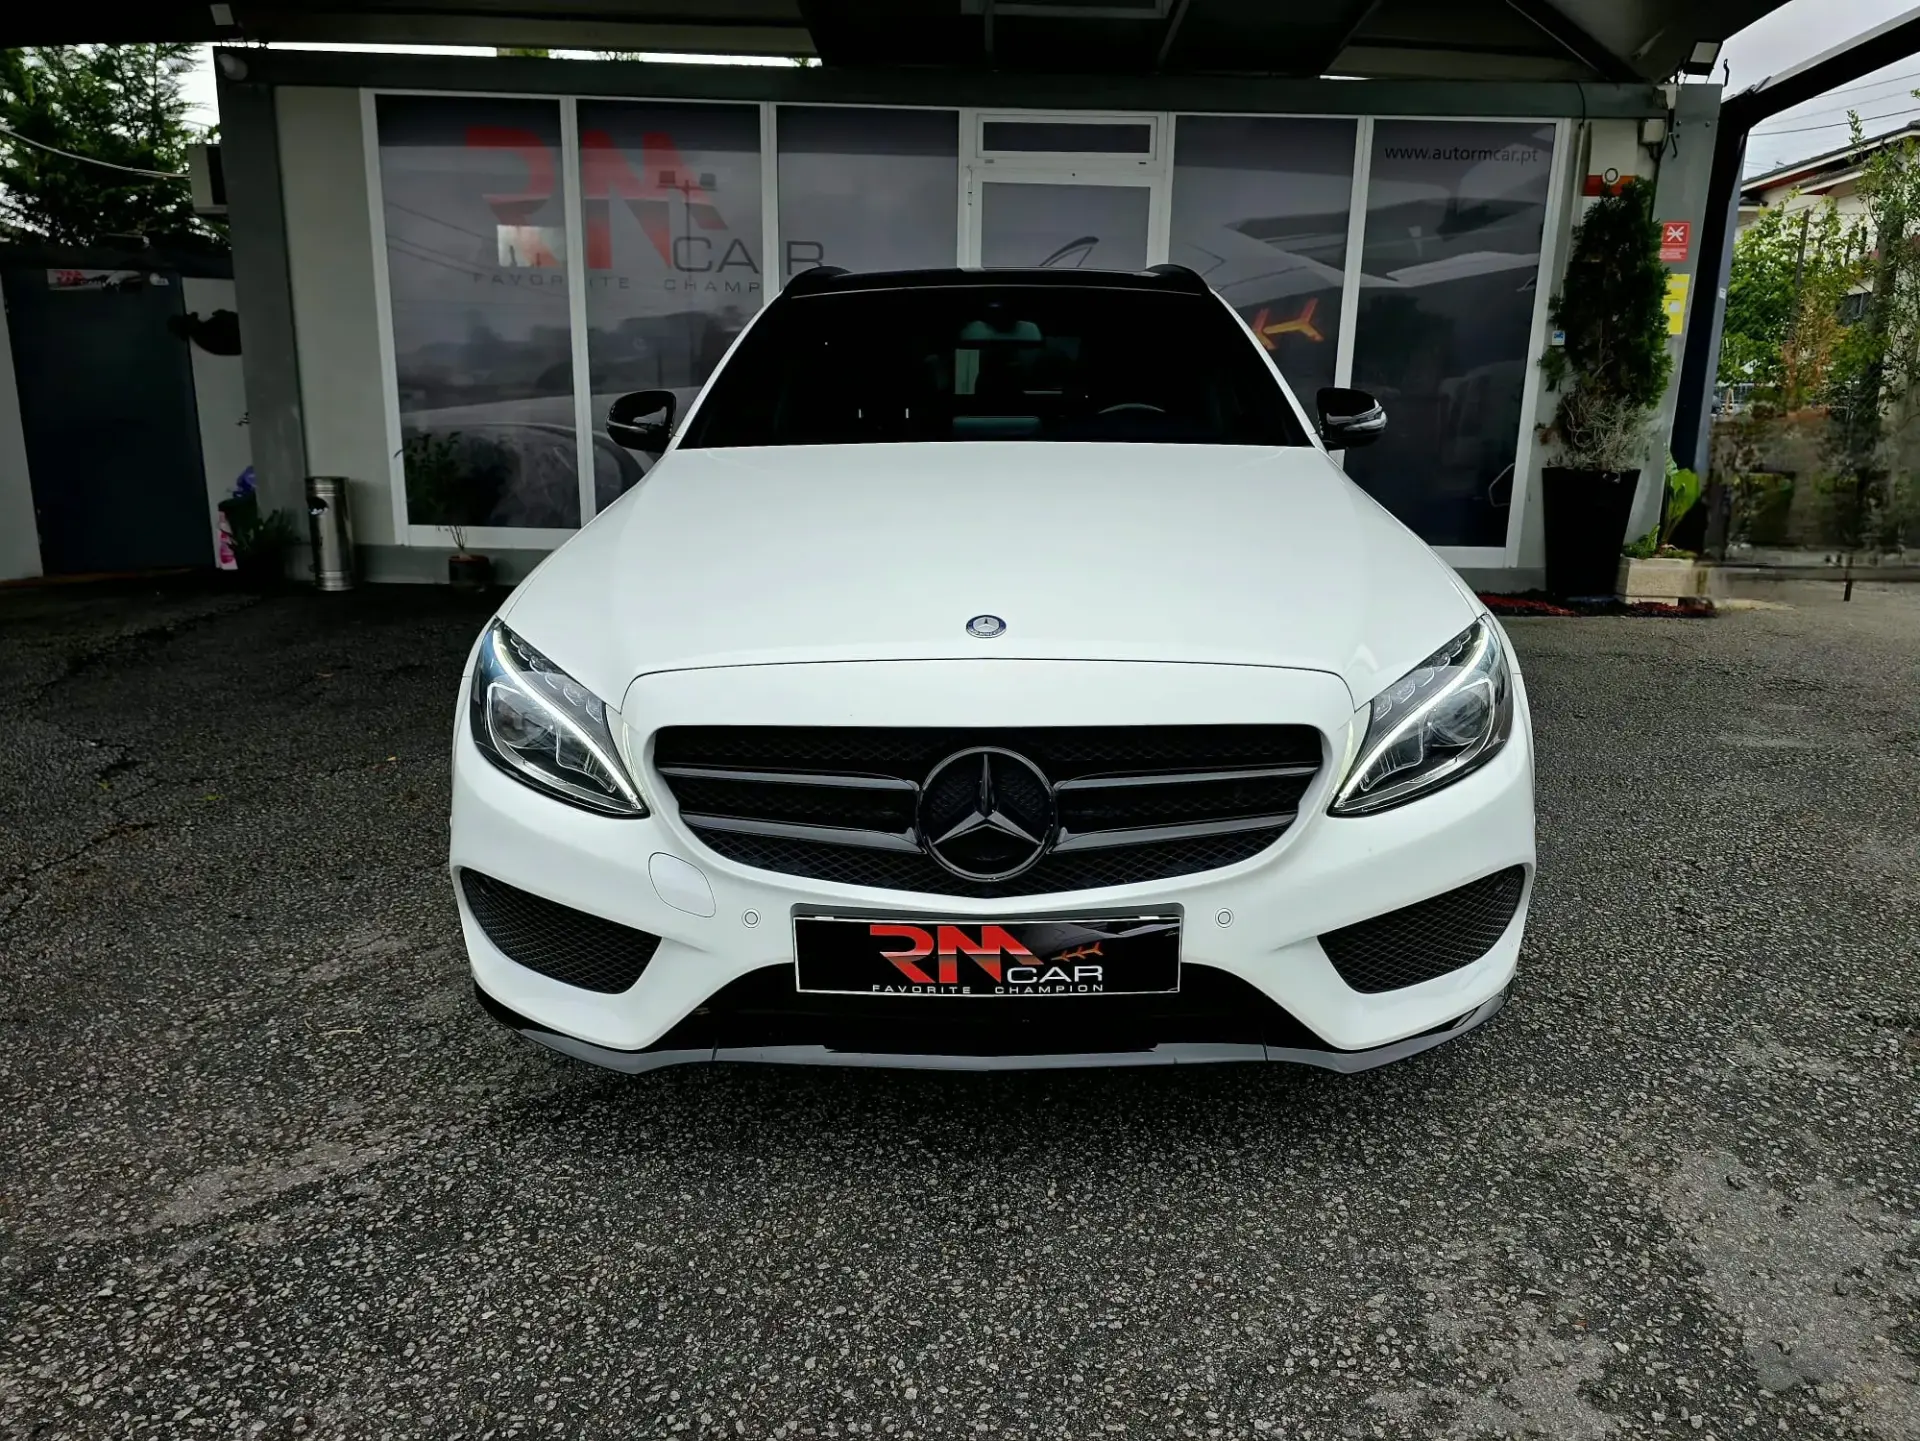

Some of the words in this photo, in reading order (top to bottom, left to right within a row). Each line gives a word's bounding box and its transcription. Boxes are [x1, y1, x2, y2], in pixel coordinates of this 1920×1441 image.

[1384, 147, 1538, 165] www.autormcar.pt
[673, 237, 824, 275] CAR
[473, 273, 630, 290] FAVORITE
[664, 279, 785, 293] CHAMP
[869, 925, 1044, 983] RM
[1007, 966, 1104, 984] CAR
[872, 984, 971, 994] FAVORITE
[995, 984, 1104, 994] CHAMPION
